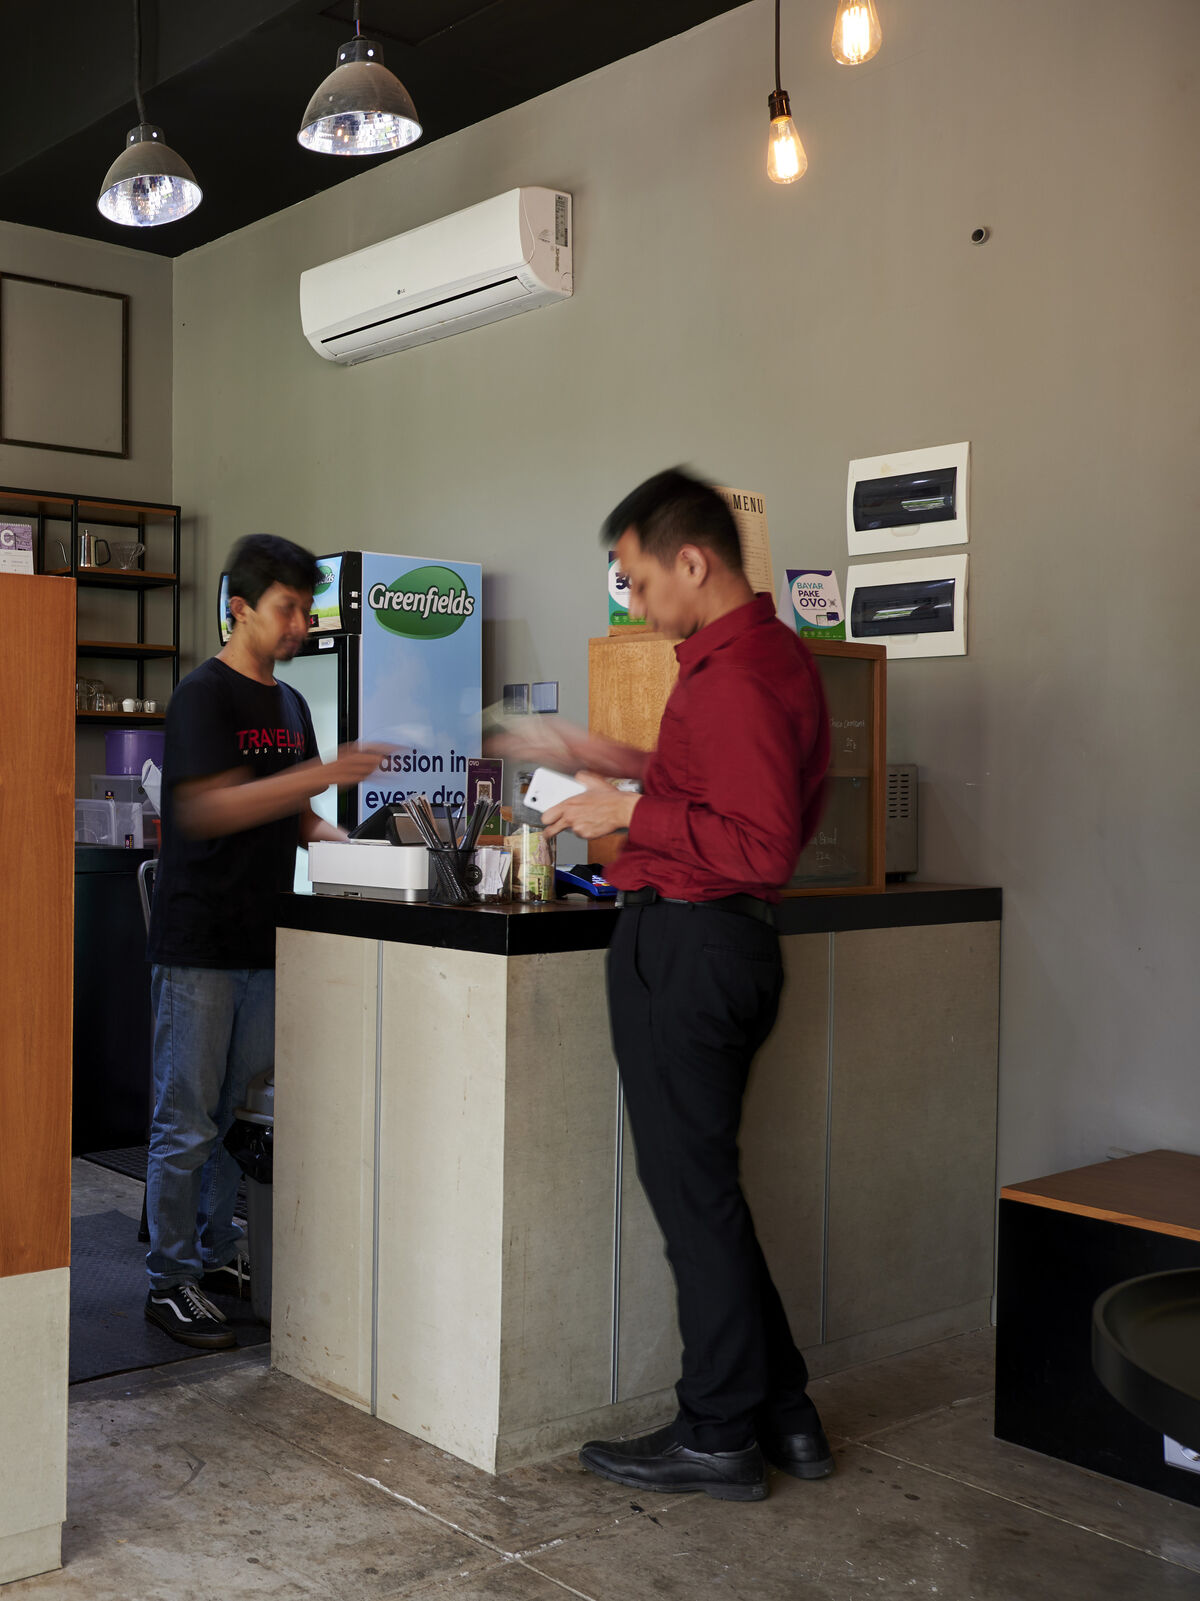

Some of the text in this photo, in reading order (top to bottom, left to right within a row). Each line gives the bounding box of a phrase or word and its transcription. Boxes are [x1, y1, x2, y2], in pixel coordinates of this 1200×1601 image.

[732, 494, 764, 514] MENU
[796, 582, 824, 590] BAYAR
[798, 590, 820, 598] PAKE
[368, 583, 475, 619] Greenfields
[799, 598, 827, 607] OVO
[379, 749, 467, 773] assion in
[432, 785, 467, 804] dro
